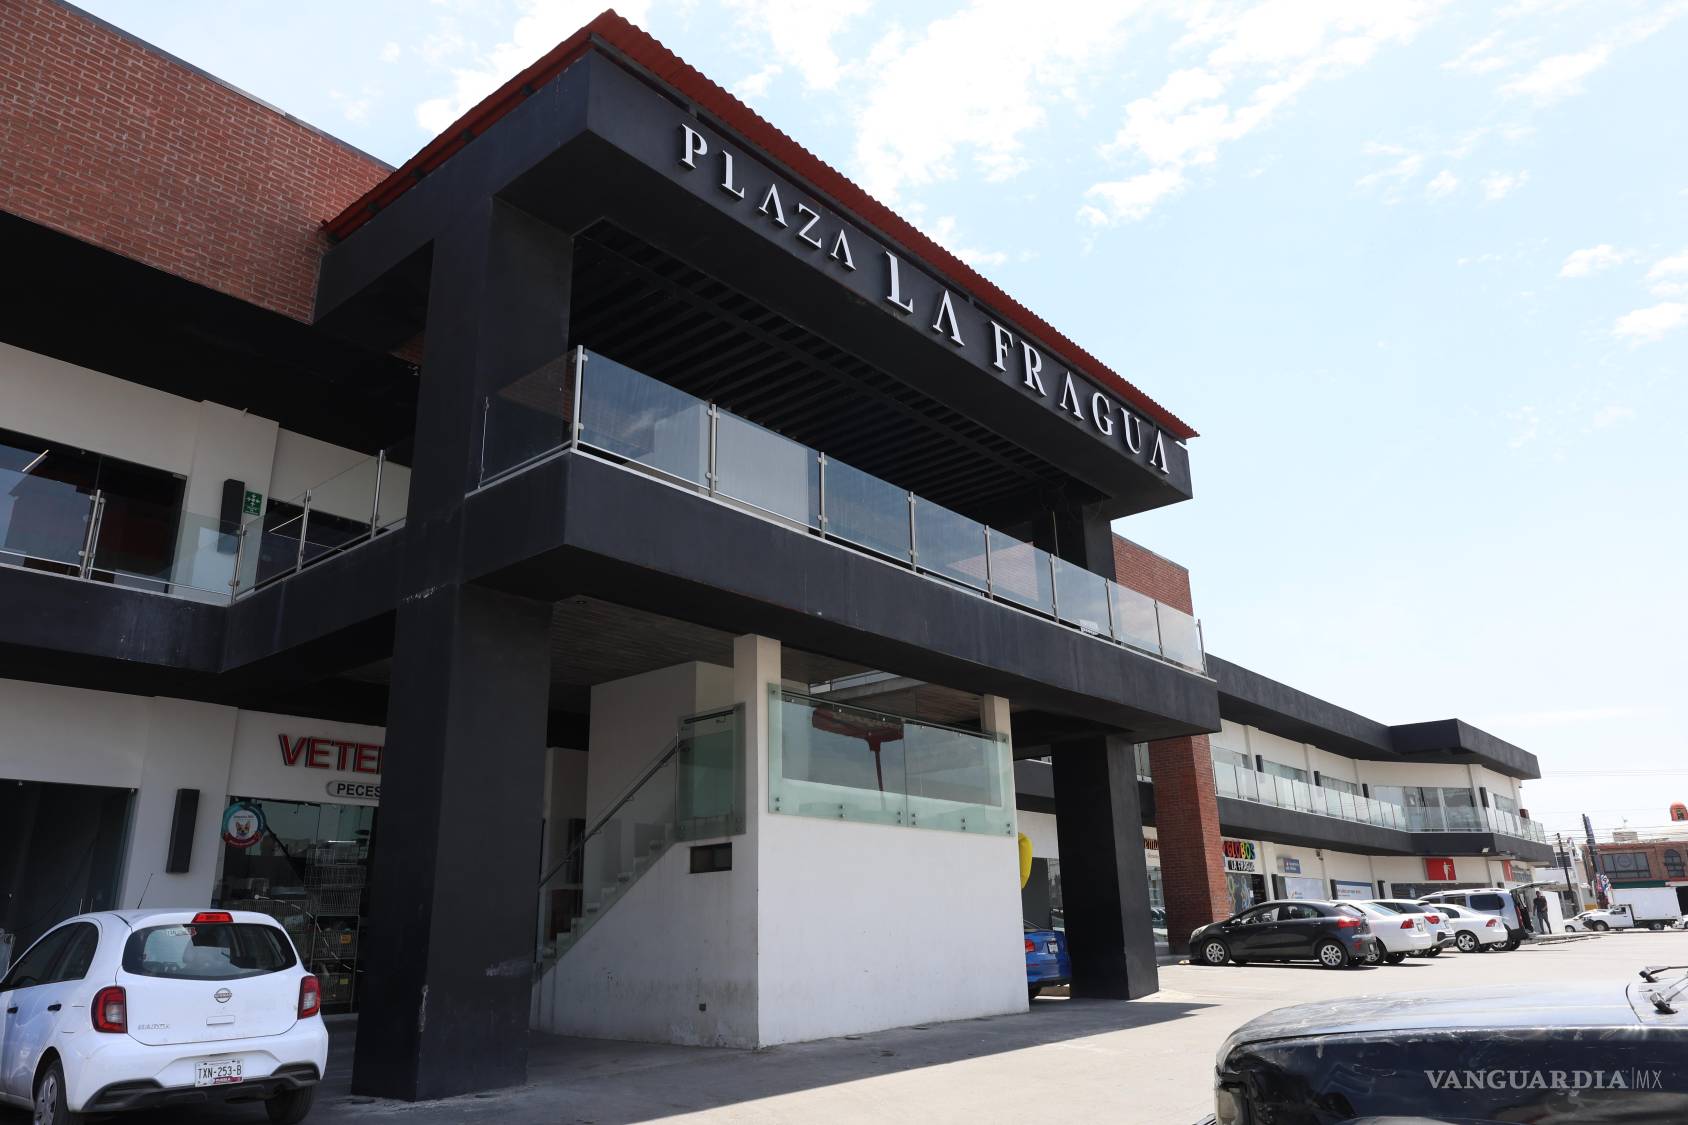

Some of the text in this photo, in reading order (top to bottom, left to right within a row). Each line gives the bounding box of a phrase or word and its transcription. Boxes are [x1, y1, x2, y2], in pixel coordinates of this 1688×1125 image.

[682, 123, 1169, 474] PLAZA LA FRAGUA
[279, 734, 385, 774] VETE
[197, 1065, 242, 1079] TXN-253-B
